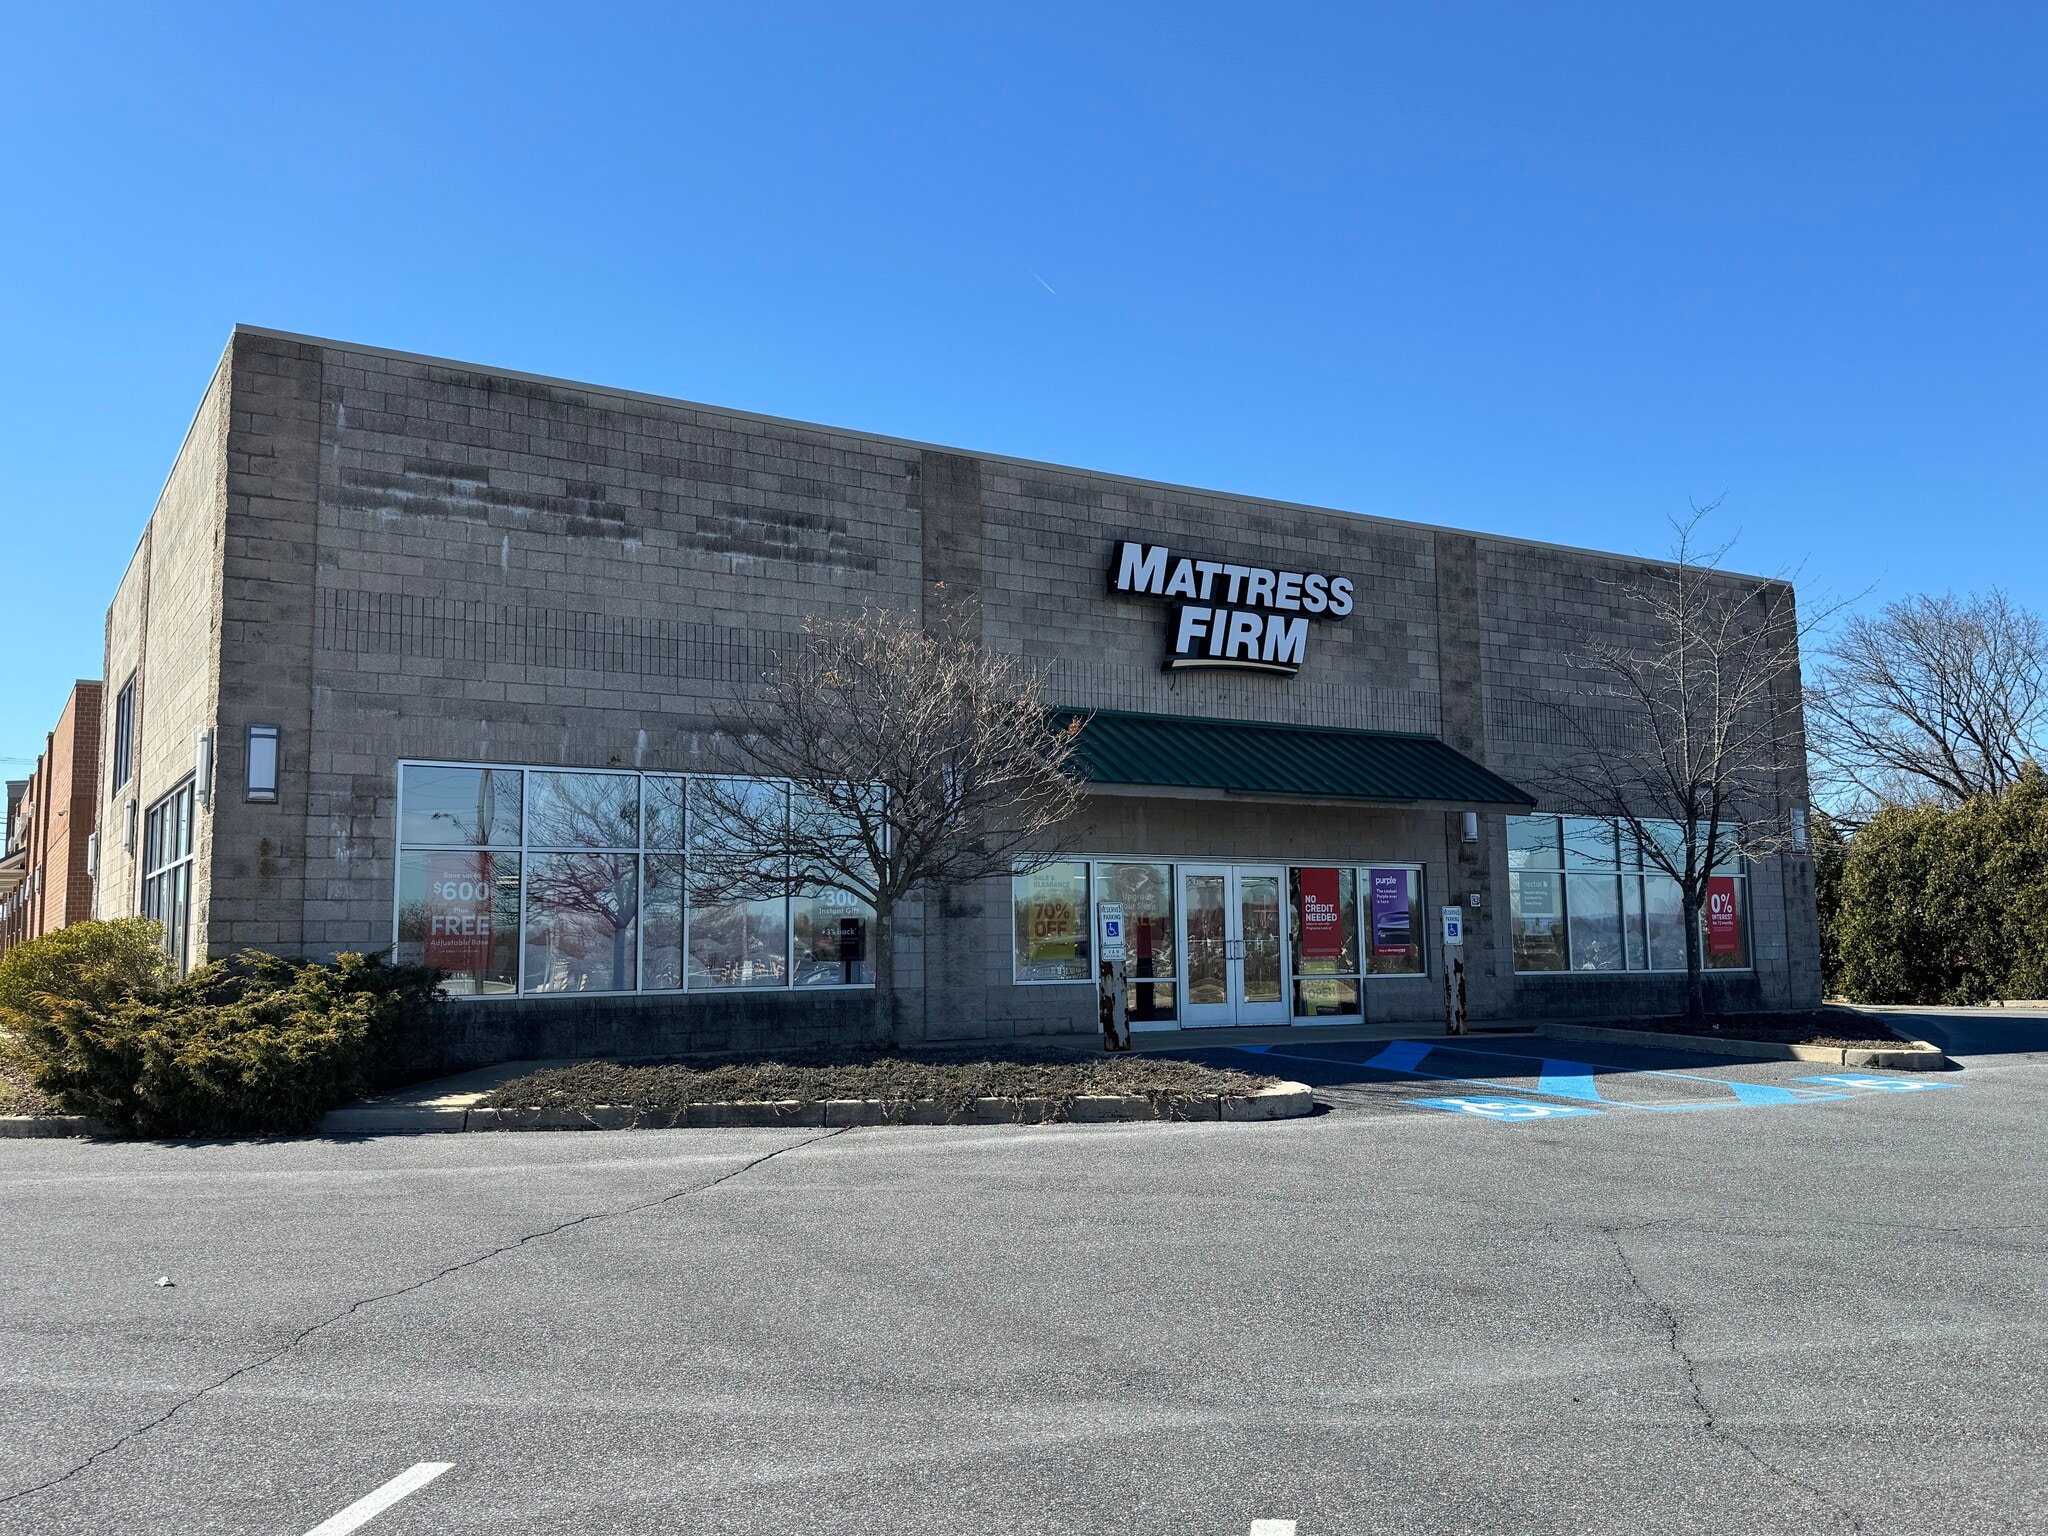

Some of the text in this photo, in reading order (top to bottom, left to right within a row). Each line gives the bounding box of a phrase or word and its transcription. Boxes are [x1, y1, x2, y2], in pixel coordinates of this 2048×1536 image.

[1117, 541, 1354, 616] MATTRESS
[1175, 605, 1310, 664] FIRM
[1375, 876, 1397, 886] purple
[433, 881, 490, 901] $600
[1305, 895, 1317, 904] NO
[1711, 893, 1733, 913] 0%
[819, 906, 859, 915] Instant Gift
[1034, 902, 1070, 919] 70%
[1305, 904, 1334, 913] CREDIT
[1305, 913, 1338, 922] NEEDED
[431, 915, 490, 936] FREE
[1034, 920, 1067, 937] OFF
[430, 939, 471, 948] Adjustable
[1308, 986, 1336, 999] OPEN
